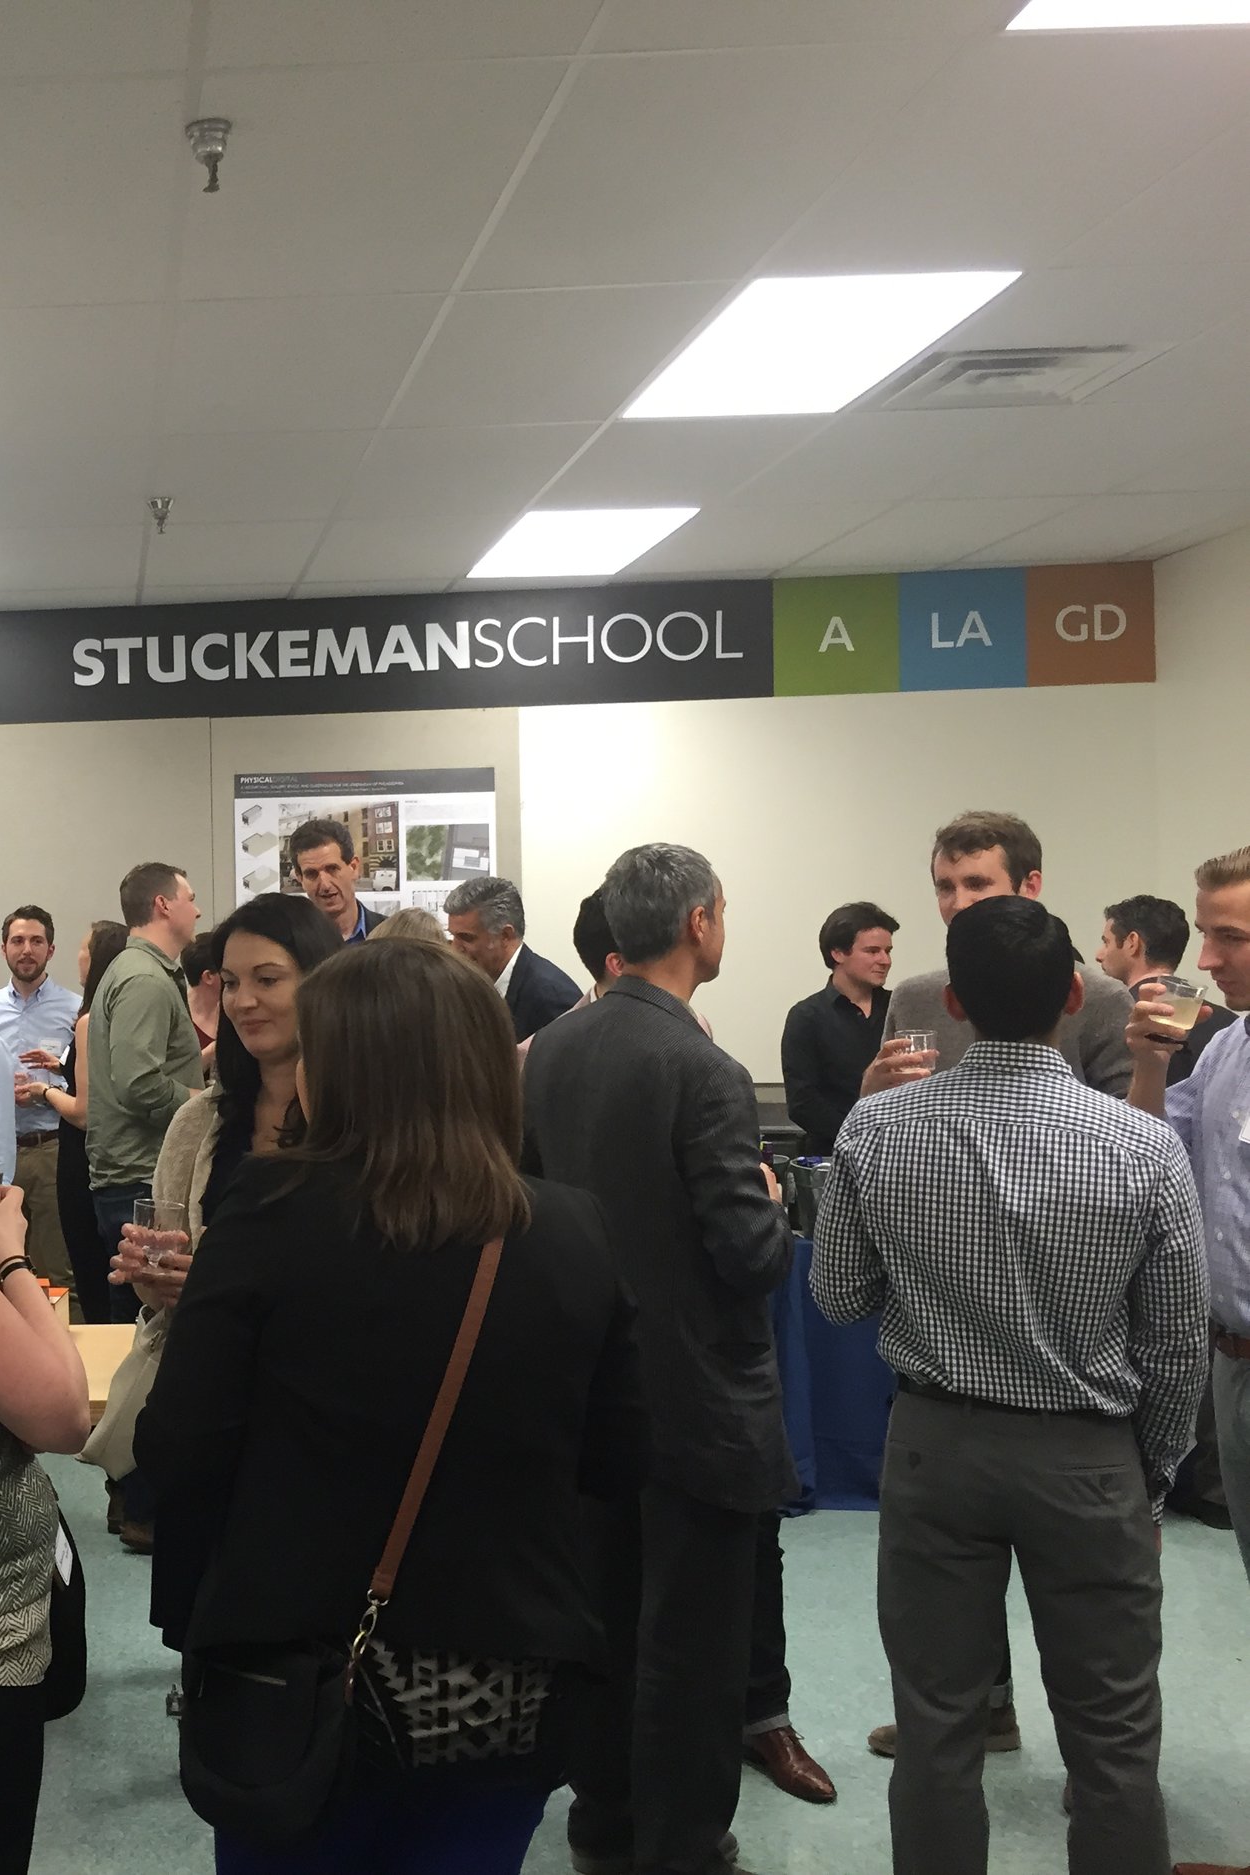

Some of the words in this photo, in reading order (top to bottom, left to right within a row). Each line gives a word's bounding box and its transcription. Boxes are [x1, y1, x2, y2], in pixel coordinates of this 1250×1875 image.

[818, 615, 855, 653] A
[930, 610, 993, 649] LA
[1055, 603, 1127, 643] GD
[240, 776, 273, 784] PHYSICAL
